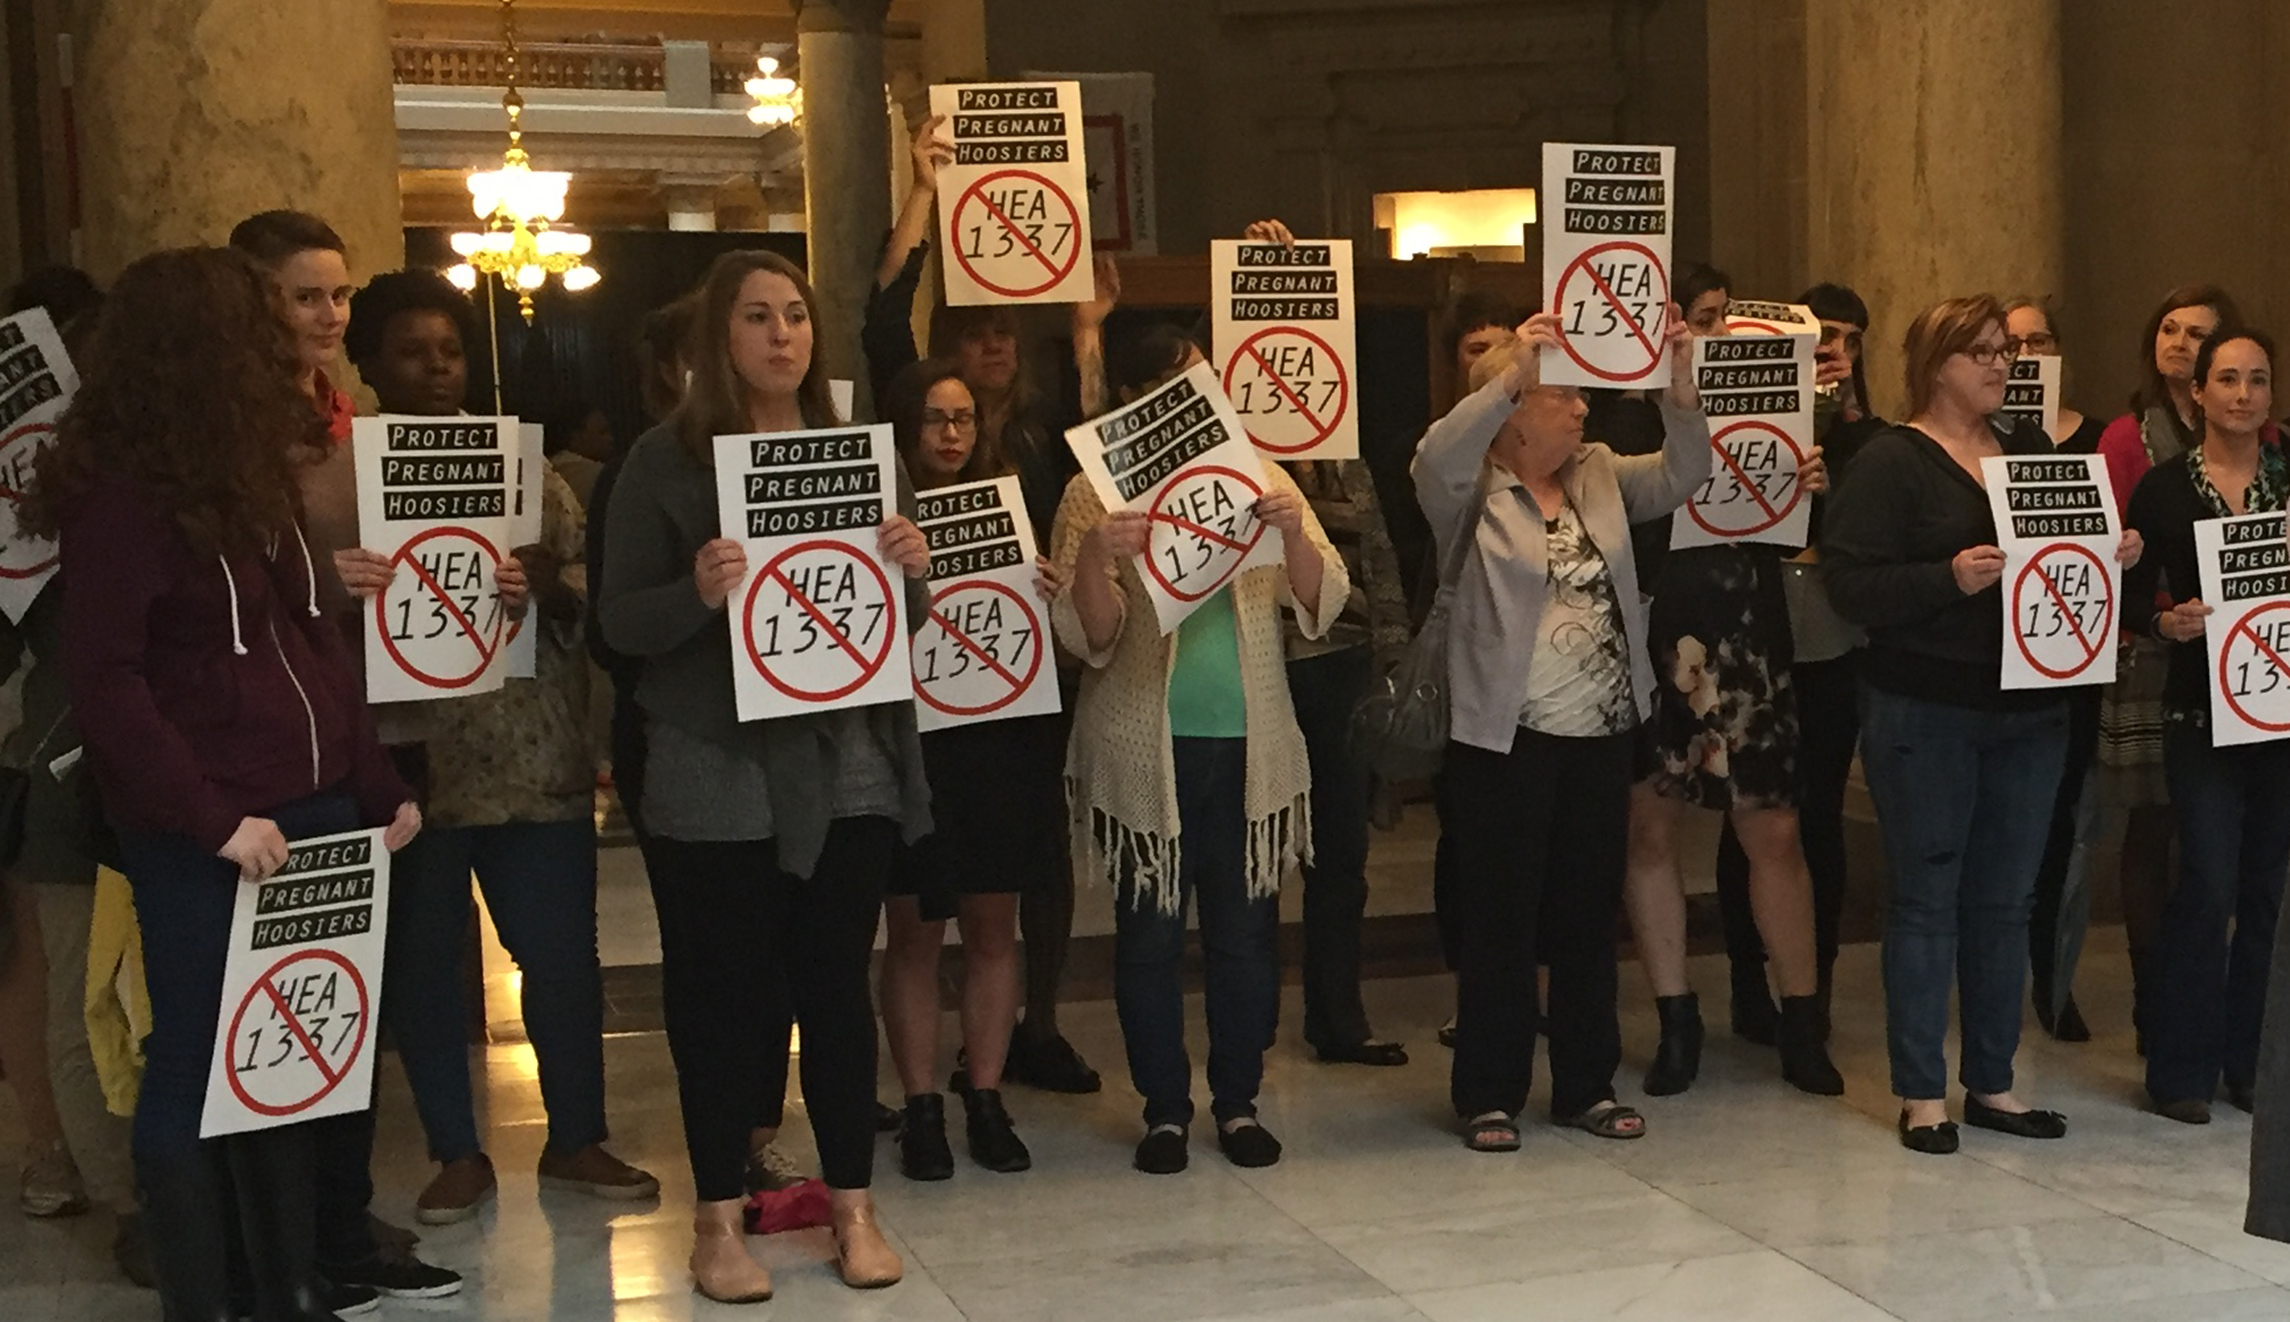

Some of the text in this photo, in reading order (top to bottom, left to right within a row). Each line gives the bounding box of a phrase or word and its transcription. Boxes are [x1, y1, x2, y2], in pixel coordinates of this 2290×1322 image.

[962, 90, 1054, 108] PROTECT
[957, 116, 1062, 135] PREGNANT
[958, 144, 1065, 162] HOOSIERS
[1576, 151, 1660, 173] PROTECT
[987, 189, 1047, 221] HEA
[1568, 180, 1664, 202] PREGNANT
[1568, 210, 1665, 232] HOOSIERS
[965, 223, 1073, 259] 1337
[1241, 247, 1327, 265] PROTECT
[1235, 273, 1335, 291] PREGNANT
[1592, 263, 1651, 297] HEA
[1235, 302, 1335, 318] HOOSIERS
[1565, 299, 1667, 338] 1337
[1257, 346, 1315, 377] HEA
[1707, 341, 1792, 360] PROTECT
[1701, 367, 1796, 387] PREGNANT
[1236, 380, 1340, 415] 1337
[1701, 394, 1797, 413] HOOSIERS
[1101, 383, 1190, 443] PROTECT
[392, 426, 494, 447] PROTECT
[756, 439, 868, 464] PROTECT
[1108, 401, 1209, 473] PREGNANT
[386, 460, 502, 482] PREGNANT
[1122, 425, 1224, 499] HOOSIERS
[1721, 440, 1778, 472] HEA
[751, 472, 877, 499] PREGNANT
[2011, 462, 2087, 481] PROTECT
[1695, 472, 1796, 506] 1337
[2010, 489, 2098, 508] PREGNANT
[389, 495, 502, 516] HOOSIERS
[752, 505, 878, 534] HOOSIERS
[917, 490, 996, 519] ROTECT
[1167, 480, 1235, 536] HEA
[931, 517, 1010, 547] EGNANT
[2016, 516, 2105, 535] HOOSIERS
[2226, 521, 2286, 542] PROTE
[417, 551, 482, 592] HEA
[925, 546, 1019, 578] OOSIERS
[2223, 548, 2286, 570] PREGN
[785, 562, 856, 607] HEA
[2043, 563, 2090, 598] HEA
[2225, 576, 2287, 597] HOOSI
[392, 593, 502, 641] 1337
[759, 603, 887, 657] 1337
[940, 597, 1003, 640] HEA
[2022, 599, 2108, 638] 1337
[2253, 621, 2290, 657] HE
[920, 629, 1032, 684] 1337
[2233, 659, 2290, 696] 13
[288, 842, 368, 871] ROTECT
[260, 876, 372, 911] PREGNANT
[254, 911, 369, 946] HOOSIERS
[270, 971, 338, 1020] HEA
[236, 1011, 360, 1072] 1337
